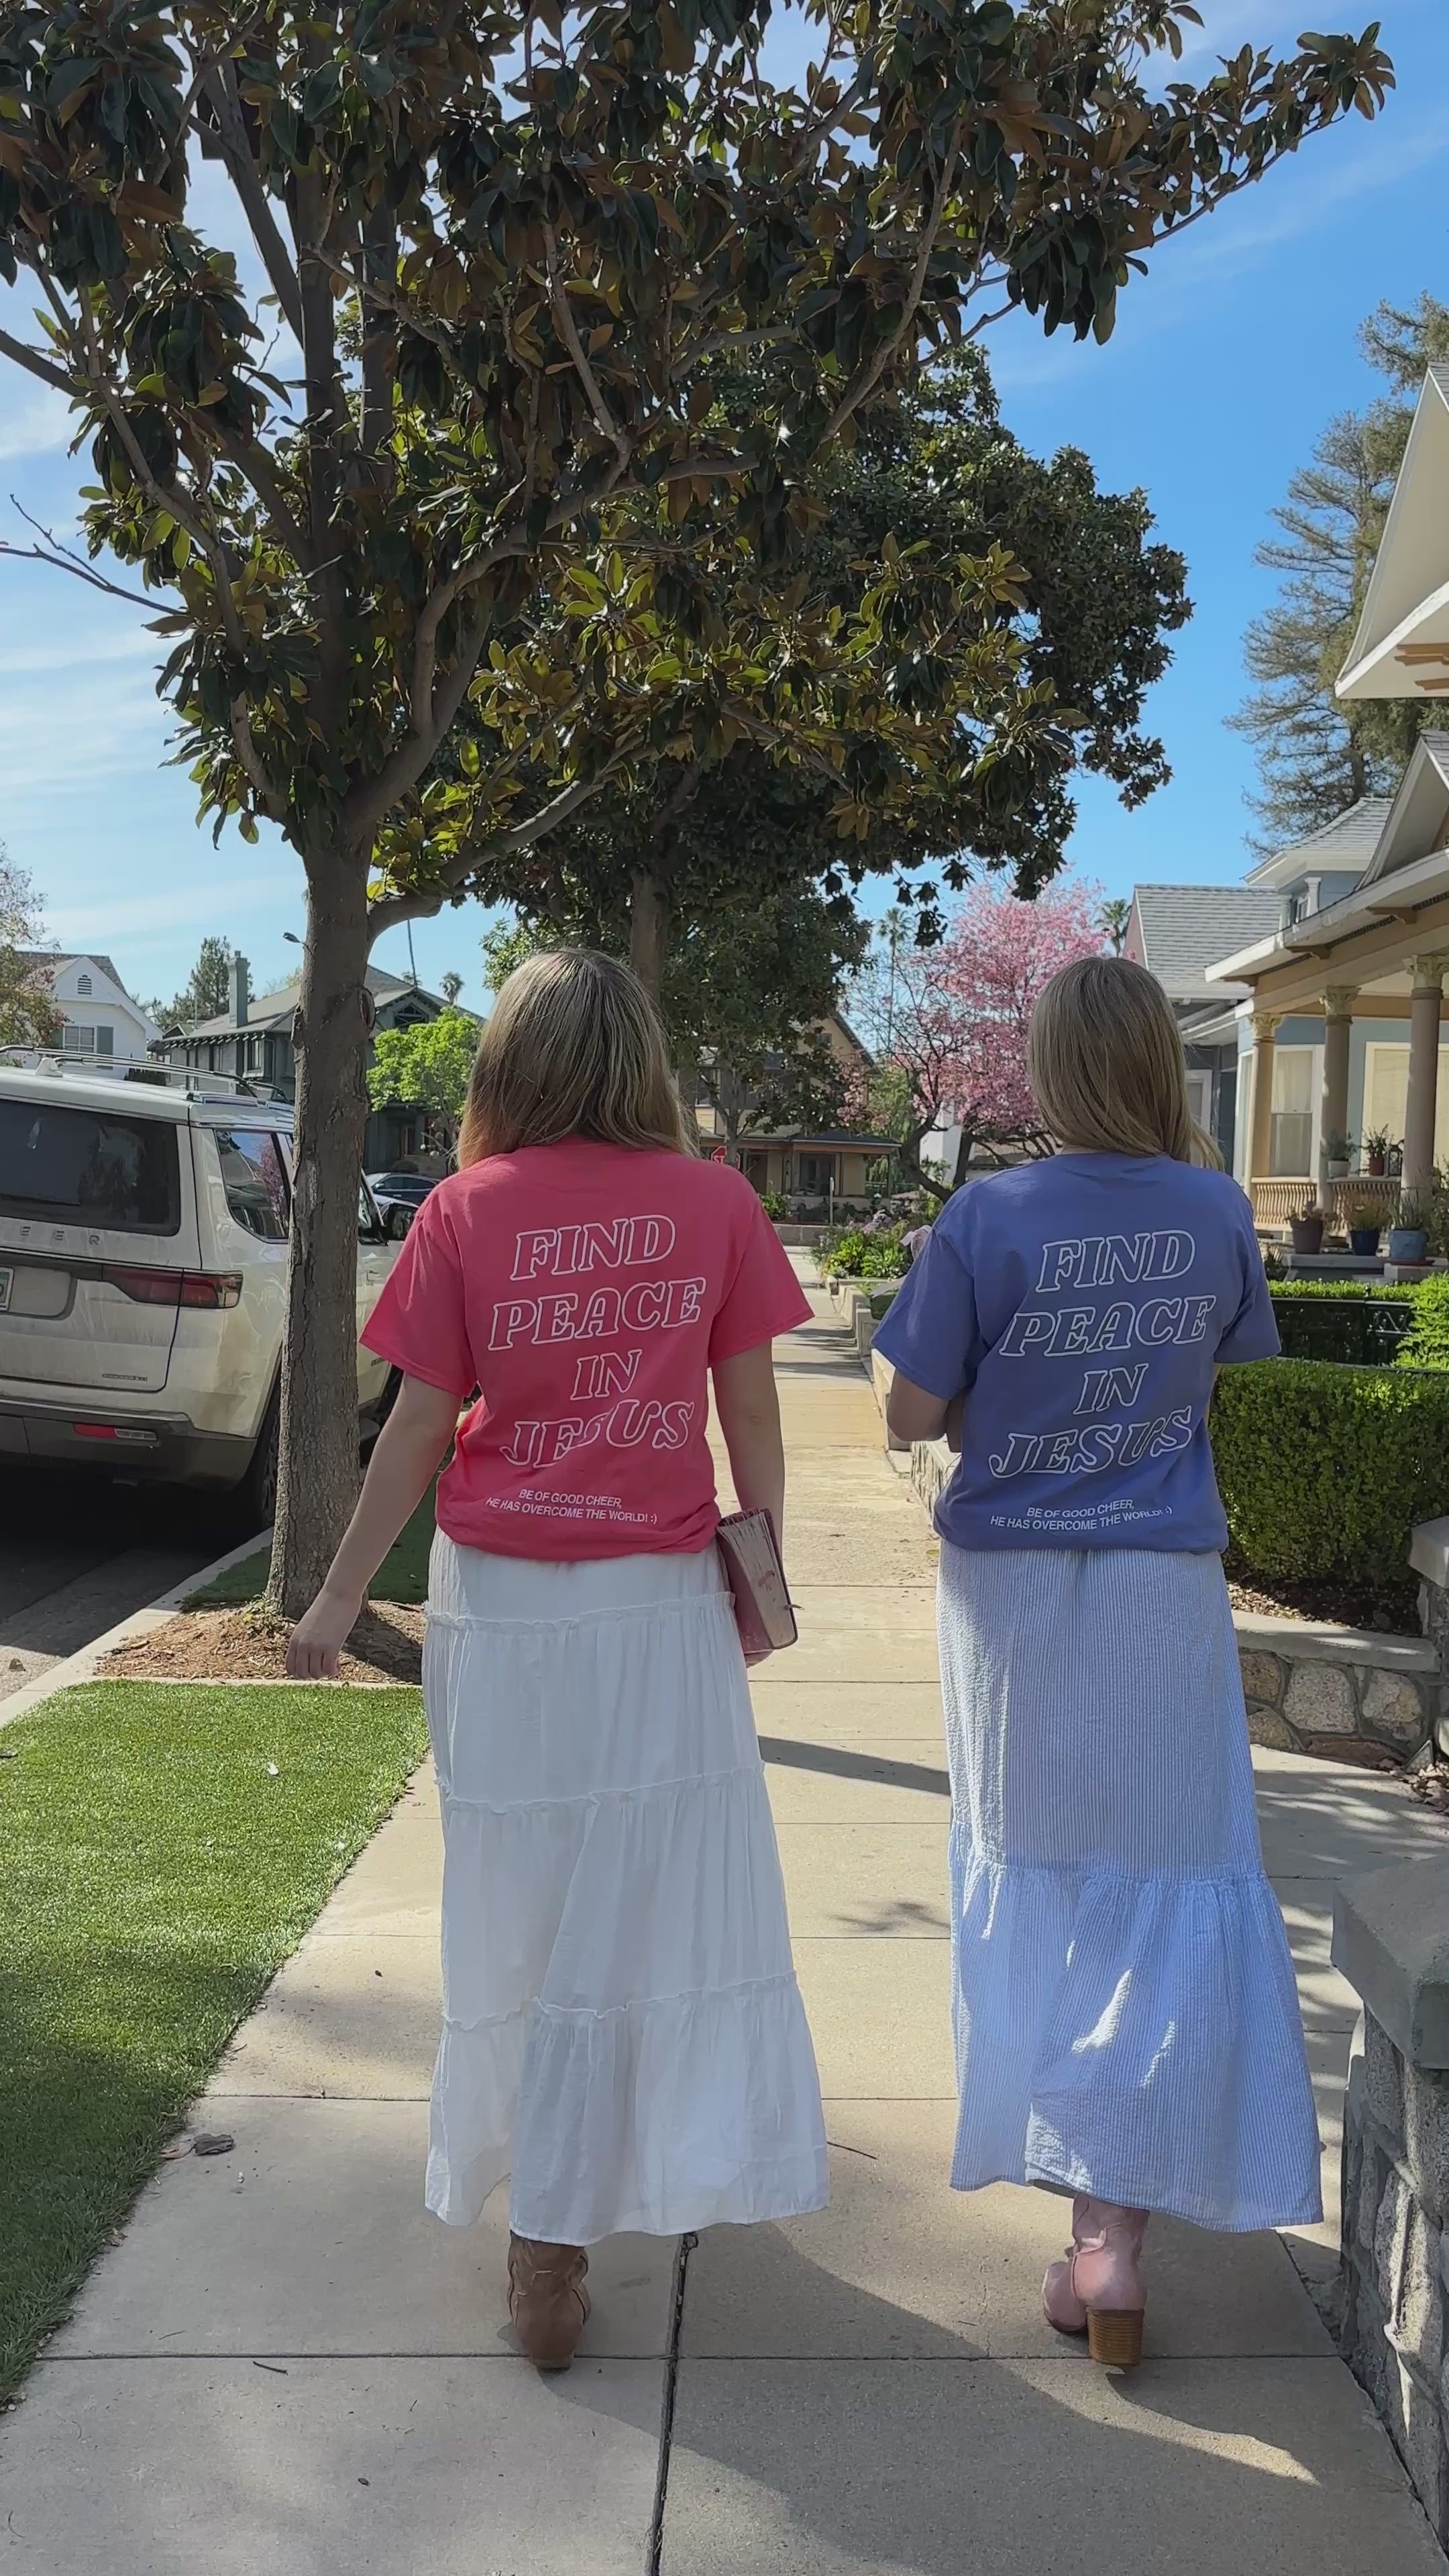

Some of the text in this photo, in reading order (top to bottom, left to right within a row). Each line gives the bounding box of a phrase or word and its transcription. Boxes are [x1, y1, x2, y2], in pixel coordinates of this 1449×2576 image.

[510, 1214, 676, 1281] FIND
[1035, 1230, 1195, 1293] FIND
[488, 1277, 706, 1351] PEACE
[999, 1295, 1217, 1357] PEACE
[570, 1349, 642, 1401] IN
[1073, 1362, 1149, 1415] IN
[988, 1405, 1192, 1479] JESUS
[485, 1497, 500, 1508] HE
[500, 1499, 521, 1512] HAS
[521, 1503, 584, 1519] OVERCOME
[586, 1509, 606, 1520] THE
[609, 1511, 649, 1523] WORLD!
[519, 1489, 623, 1509] BE OF GOOD CHEER,
[990, 1515, 1006, 1527] HE
[1006, 1519, 1030, 1529] HAS
[1032, 1519, 1097, 1531] OVERCOME
[1099, 1514, 1122, 1527] THE
[1026, 1499, 1134, 1518] BE OF GOOD CHEER,
